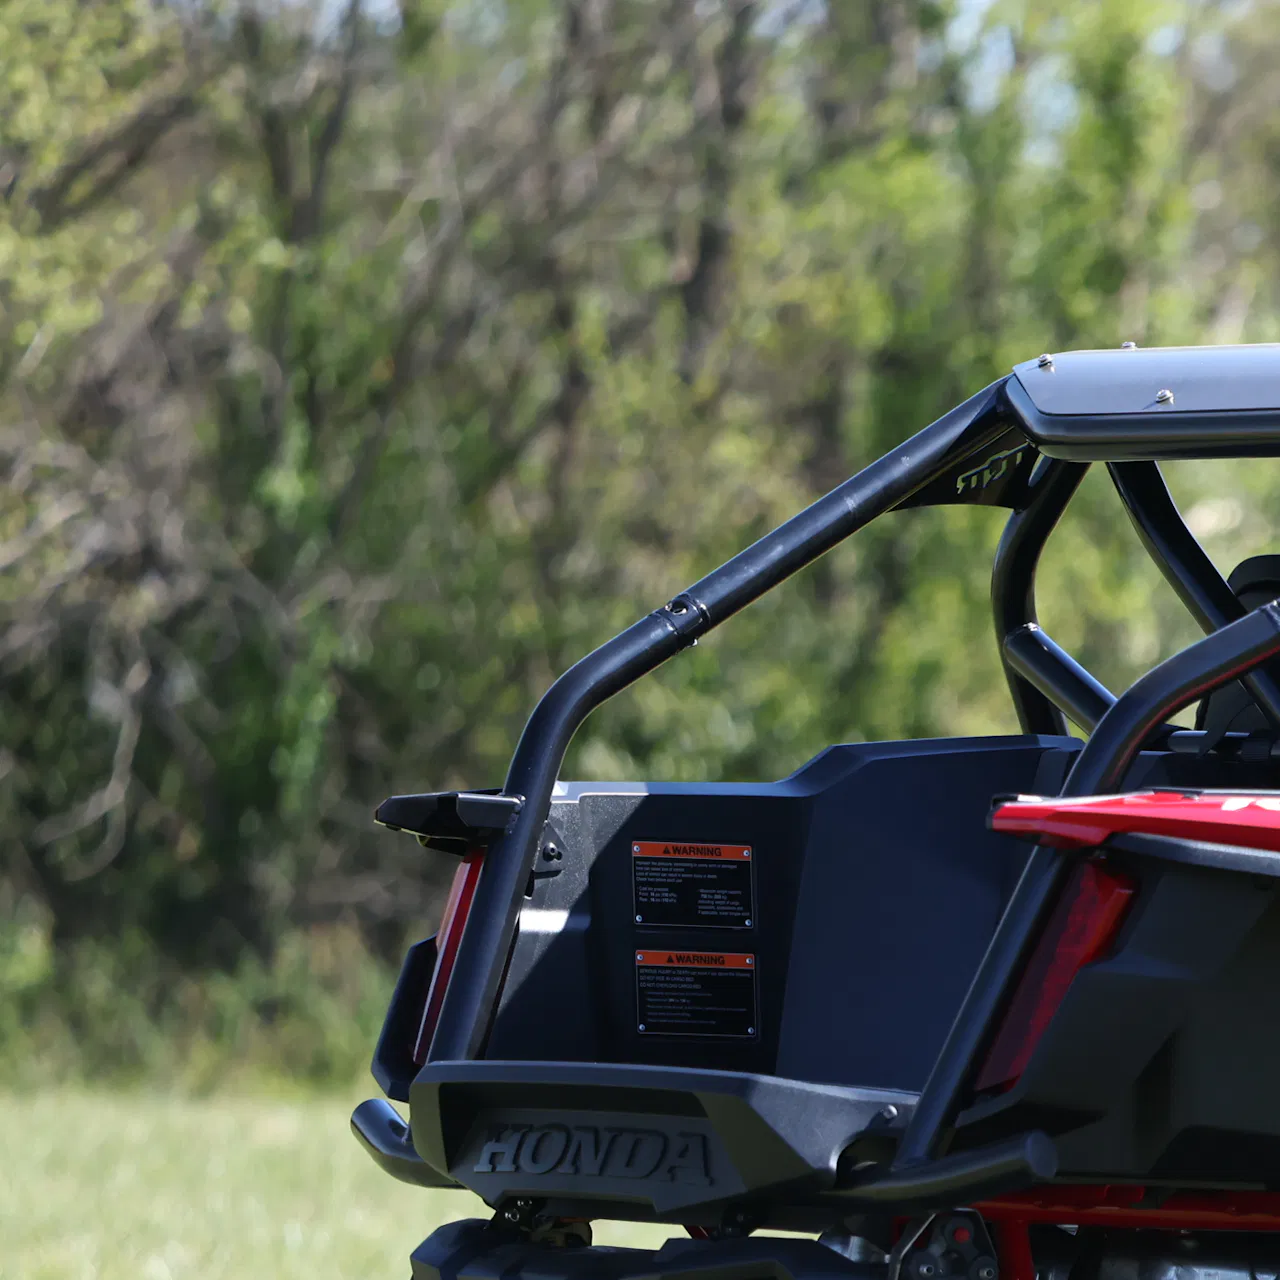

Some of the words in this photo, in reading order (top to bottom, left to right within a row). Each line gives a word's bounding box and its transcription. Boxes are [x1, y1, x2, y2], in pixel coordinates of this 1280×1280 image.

[672, 846, 722, 857] WARNING
[676, 954, 725, 965] WARNING
[473, 1123, 716, 1187] HONDA
